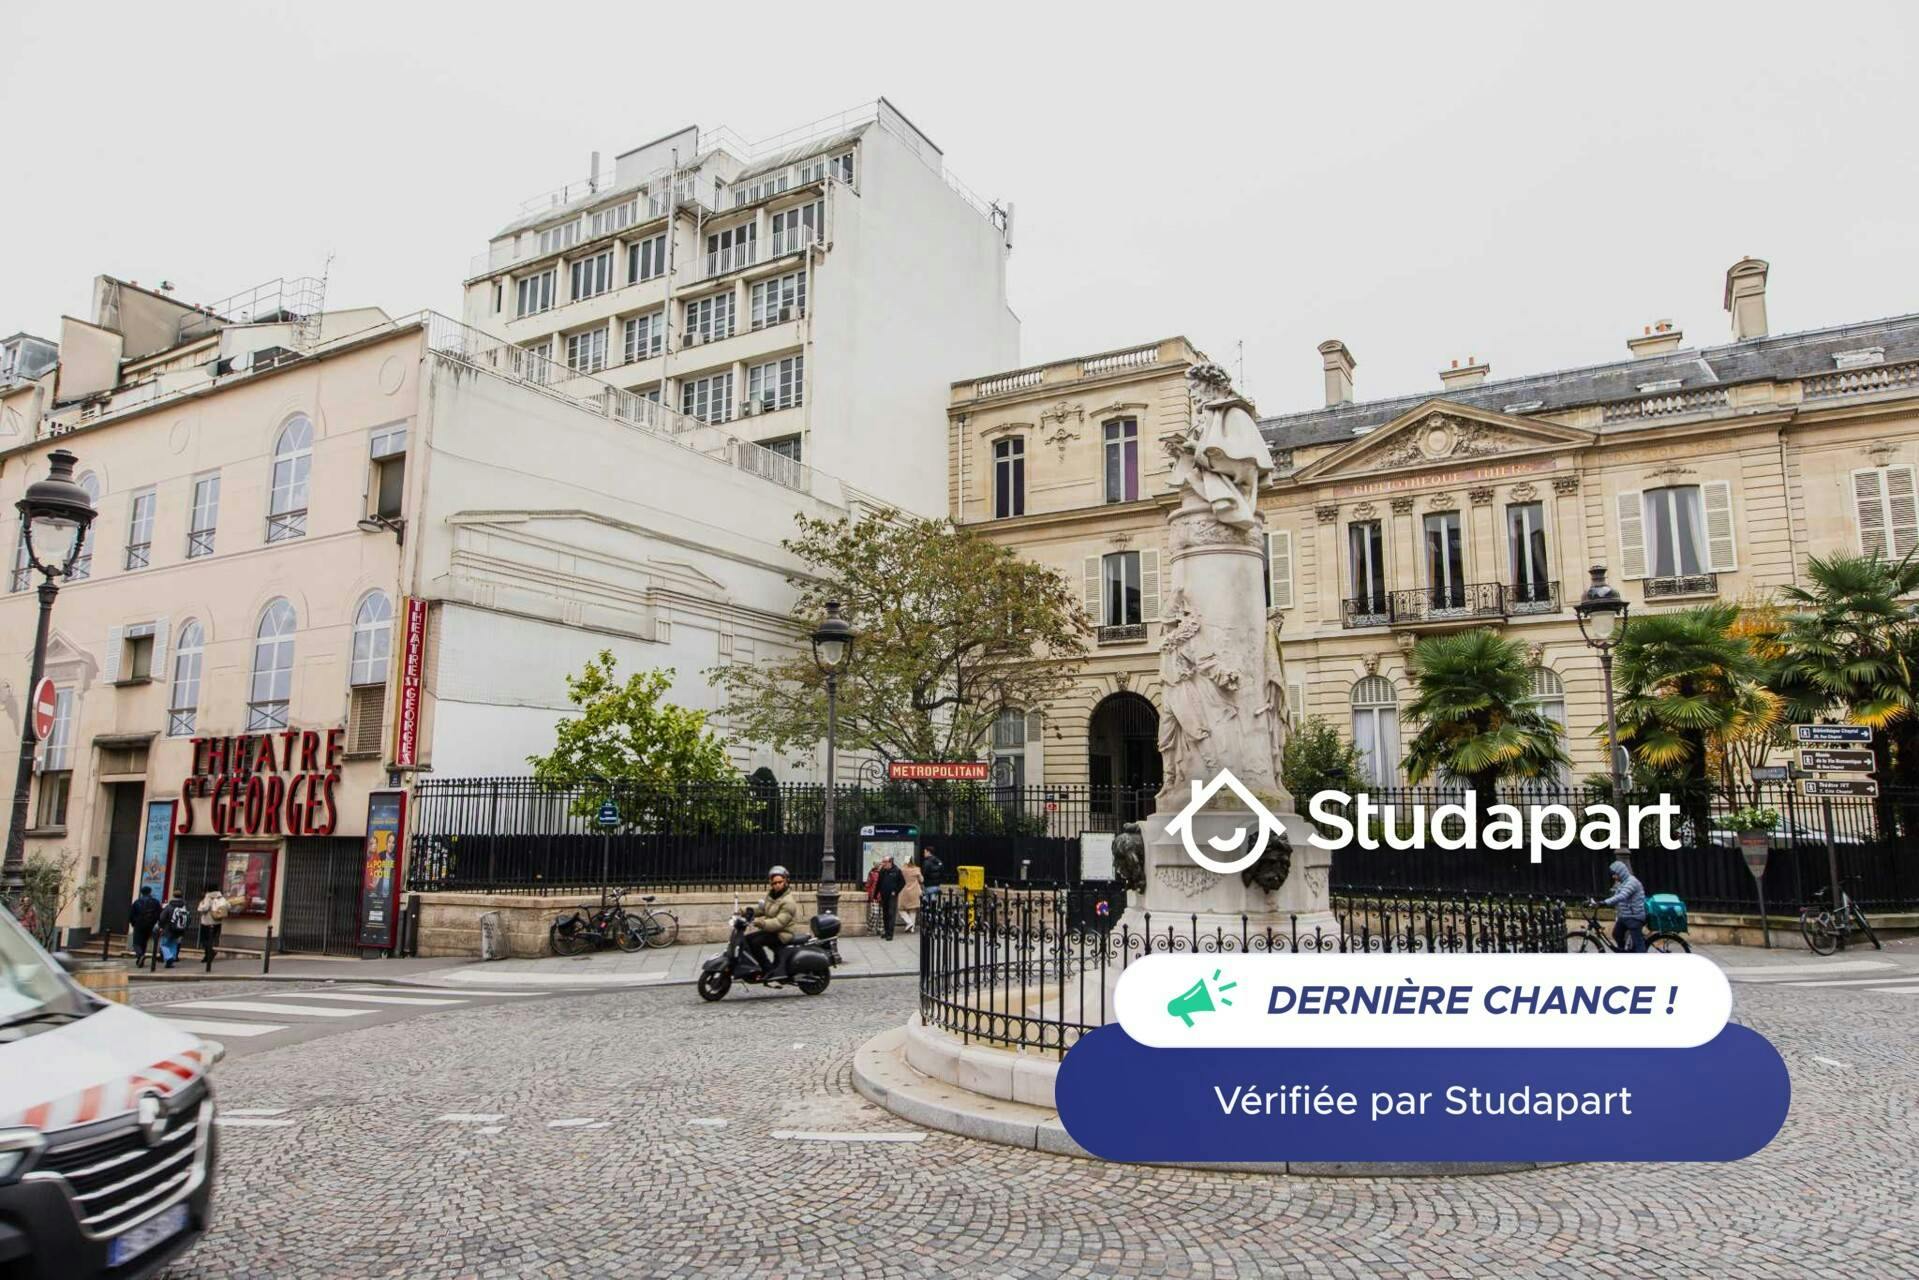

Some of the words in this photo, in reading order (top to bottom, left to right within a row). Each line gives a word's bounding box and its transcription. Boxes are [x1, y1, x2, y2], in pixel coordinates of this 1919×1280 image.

[190, 729, 344, 776] THEATRE
[892, 765, 985, 777] METROPOLITAIN
[211, 773, 341, 835] GEORGES
